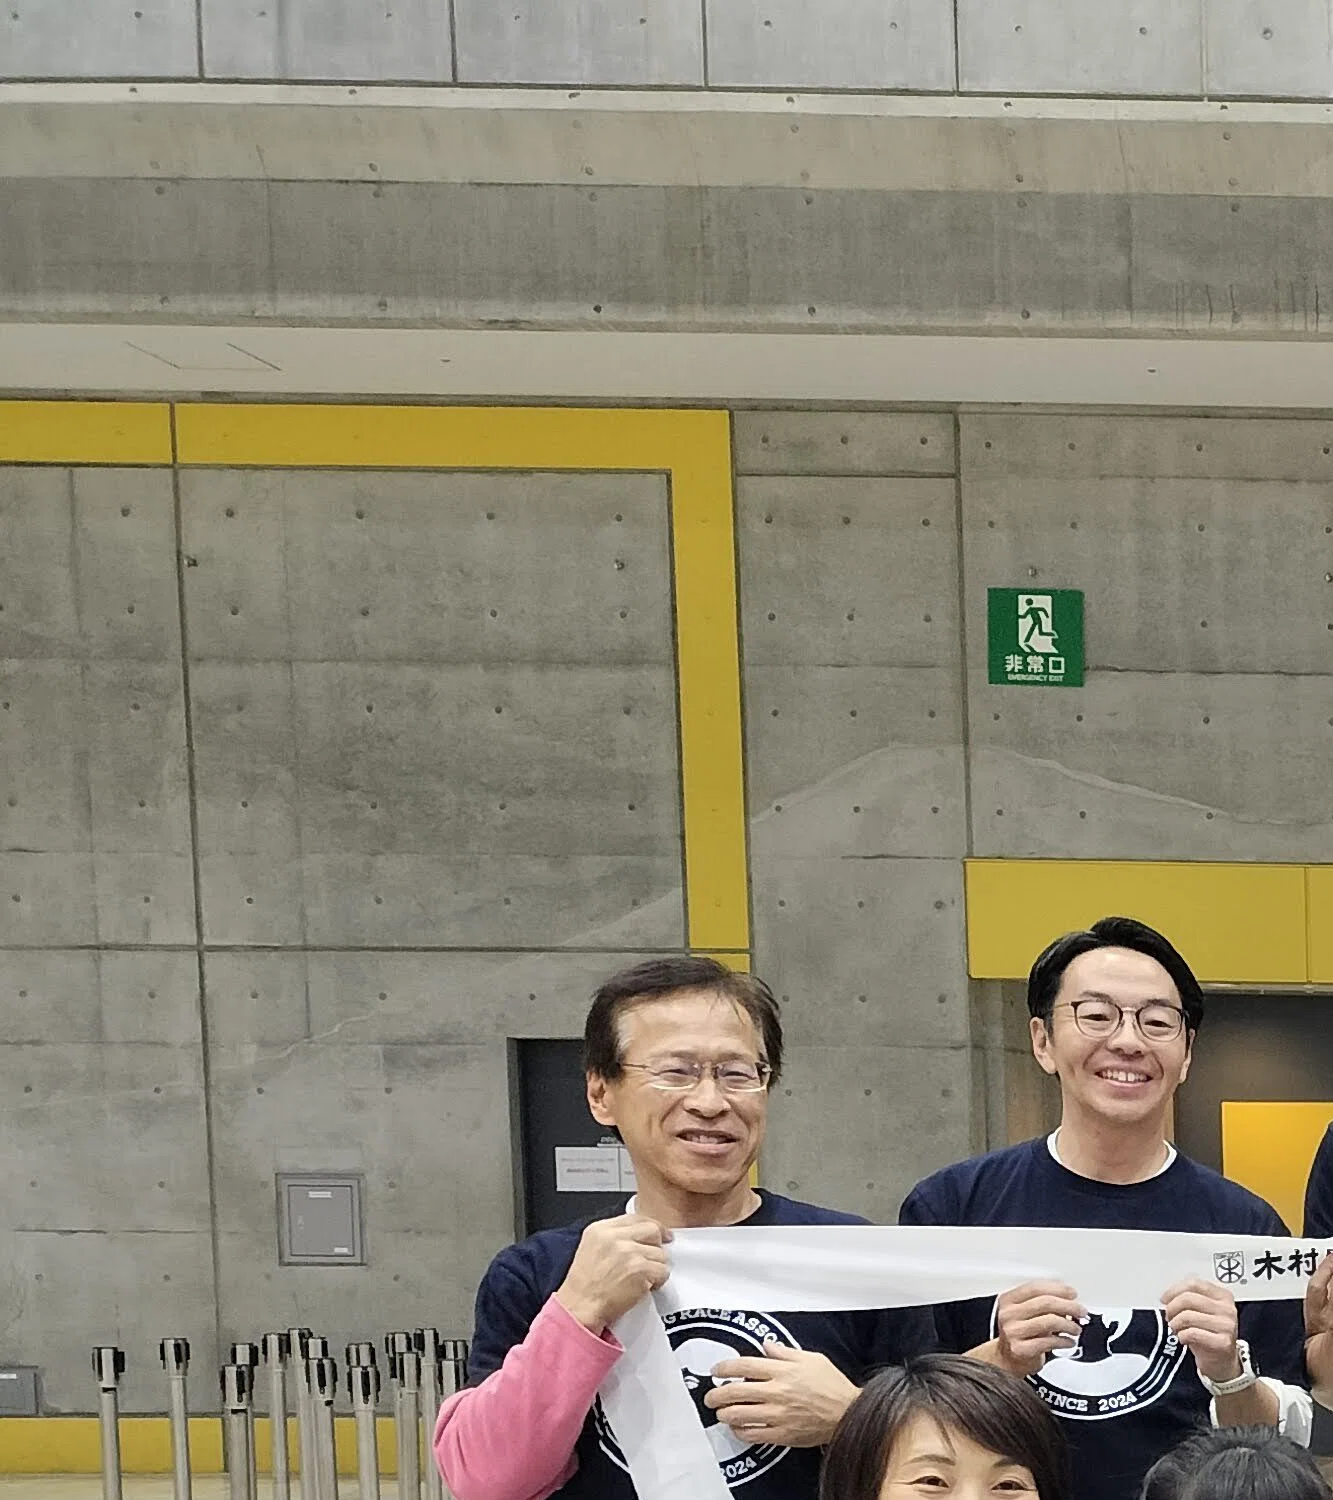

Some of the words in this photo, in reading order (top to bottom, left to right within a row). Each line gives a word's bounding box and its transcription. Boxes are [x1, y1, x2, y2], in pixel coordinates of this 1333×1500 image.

[1004, 653, 1065, 674] 非常口
[679, 1308, 731, 1322] RACE
[1037, 1386, 1089, 1412] SINCE
[1098, 1391, 1138, 1412] 2024
